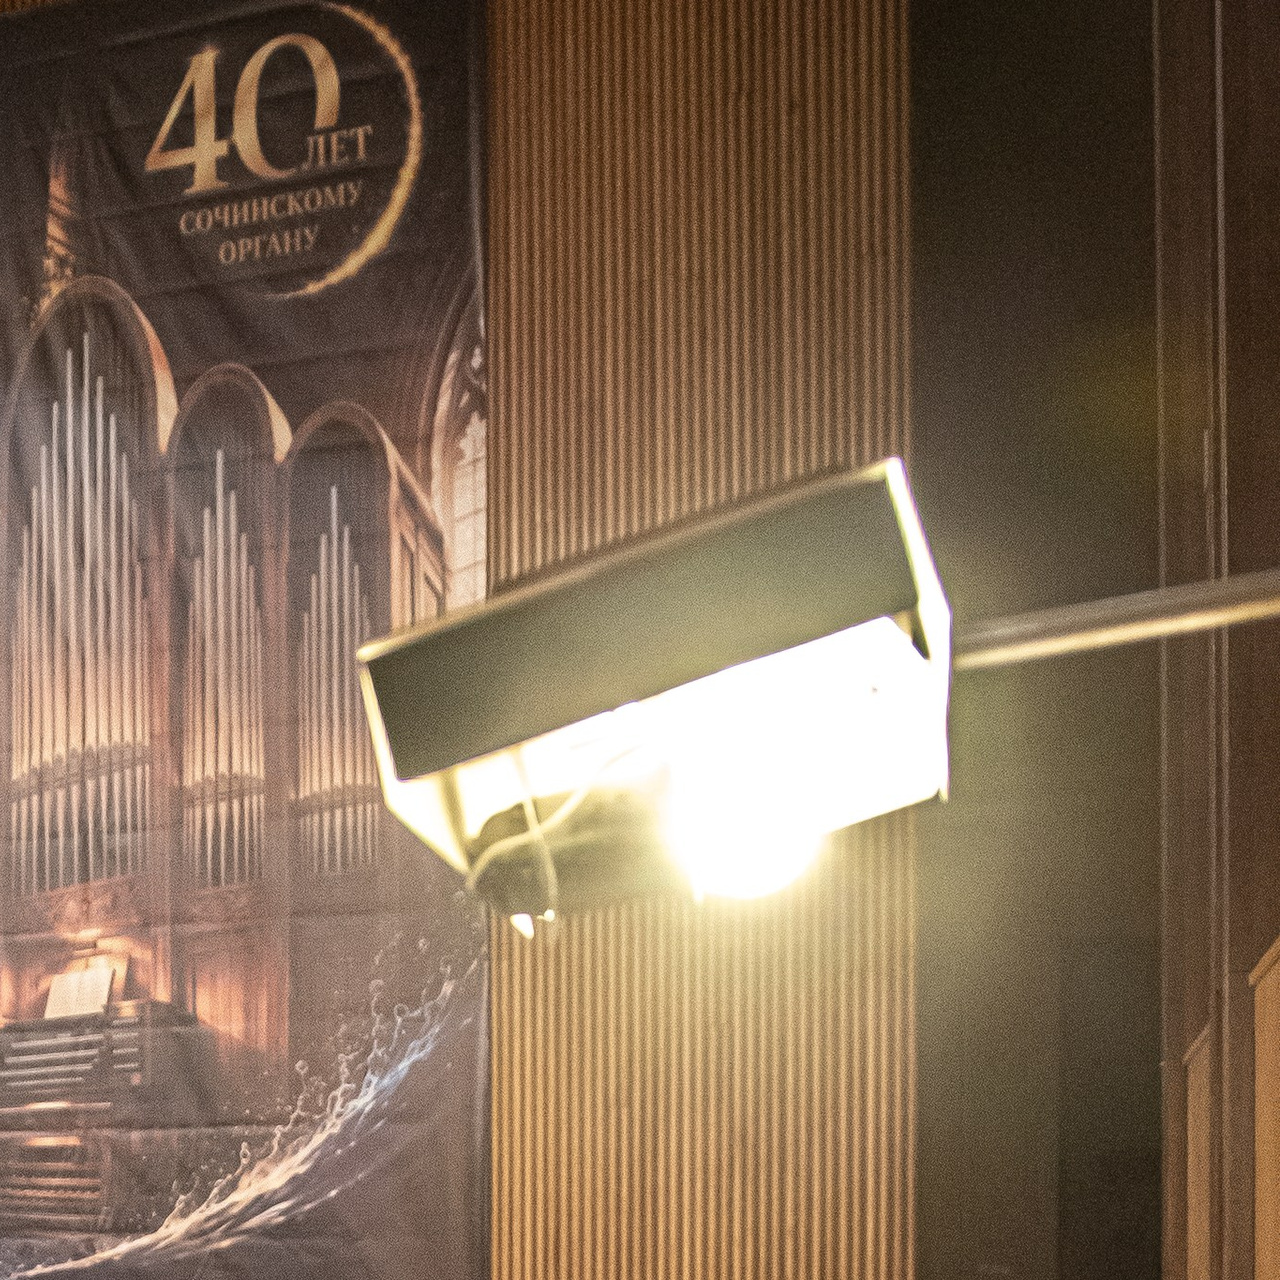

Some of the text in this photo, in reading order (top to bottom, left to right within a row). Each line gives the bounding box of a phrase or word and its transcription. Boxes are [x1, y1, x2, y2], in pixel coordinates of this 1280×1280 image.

[145, 33, 341, 195] 40
[302, 125, 373, 171] ЛЕТ
[179, 179, 363, 236] СОЧИНСКОМУ
[219, 225, 319, 266] ОРГАНУ
